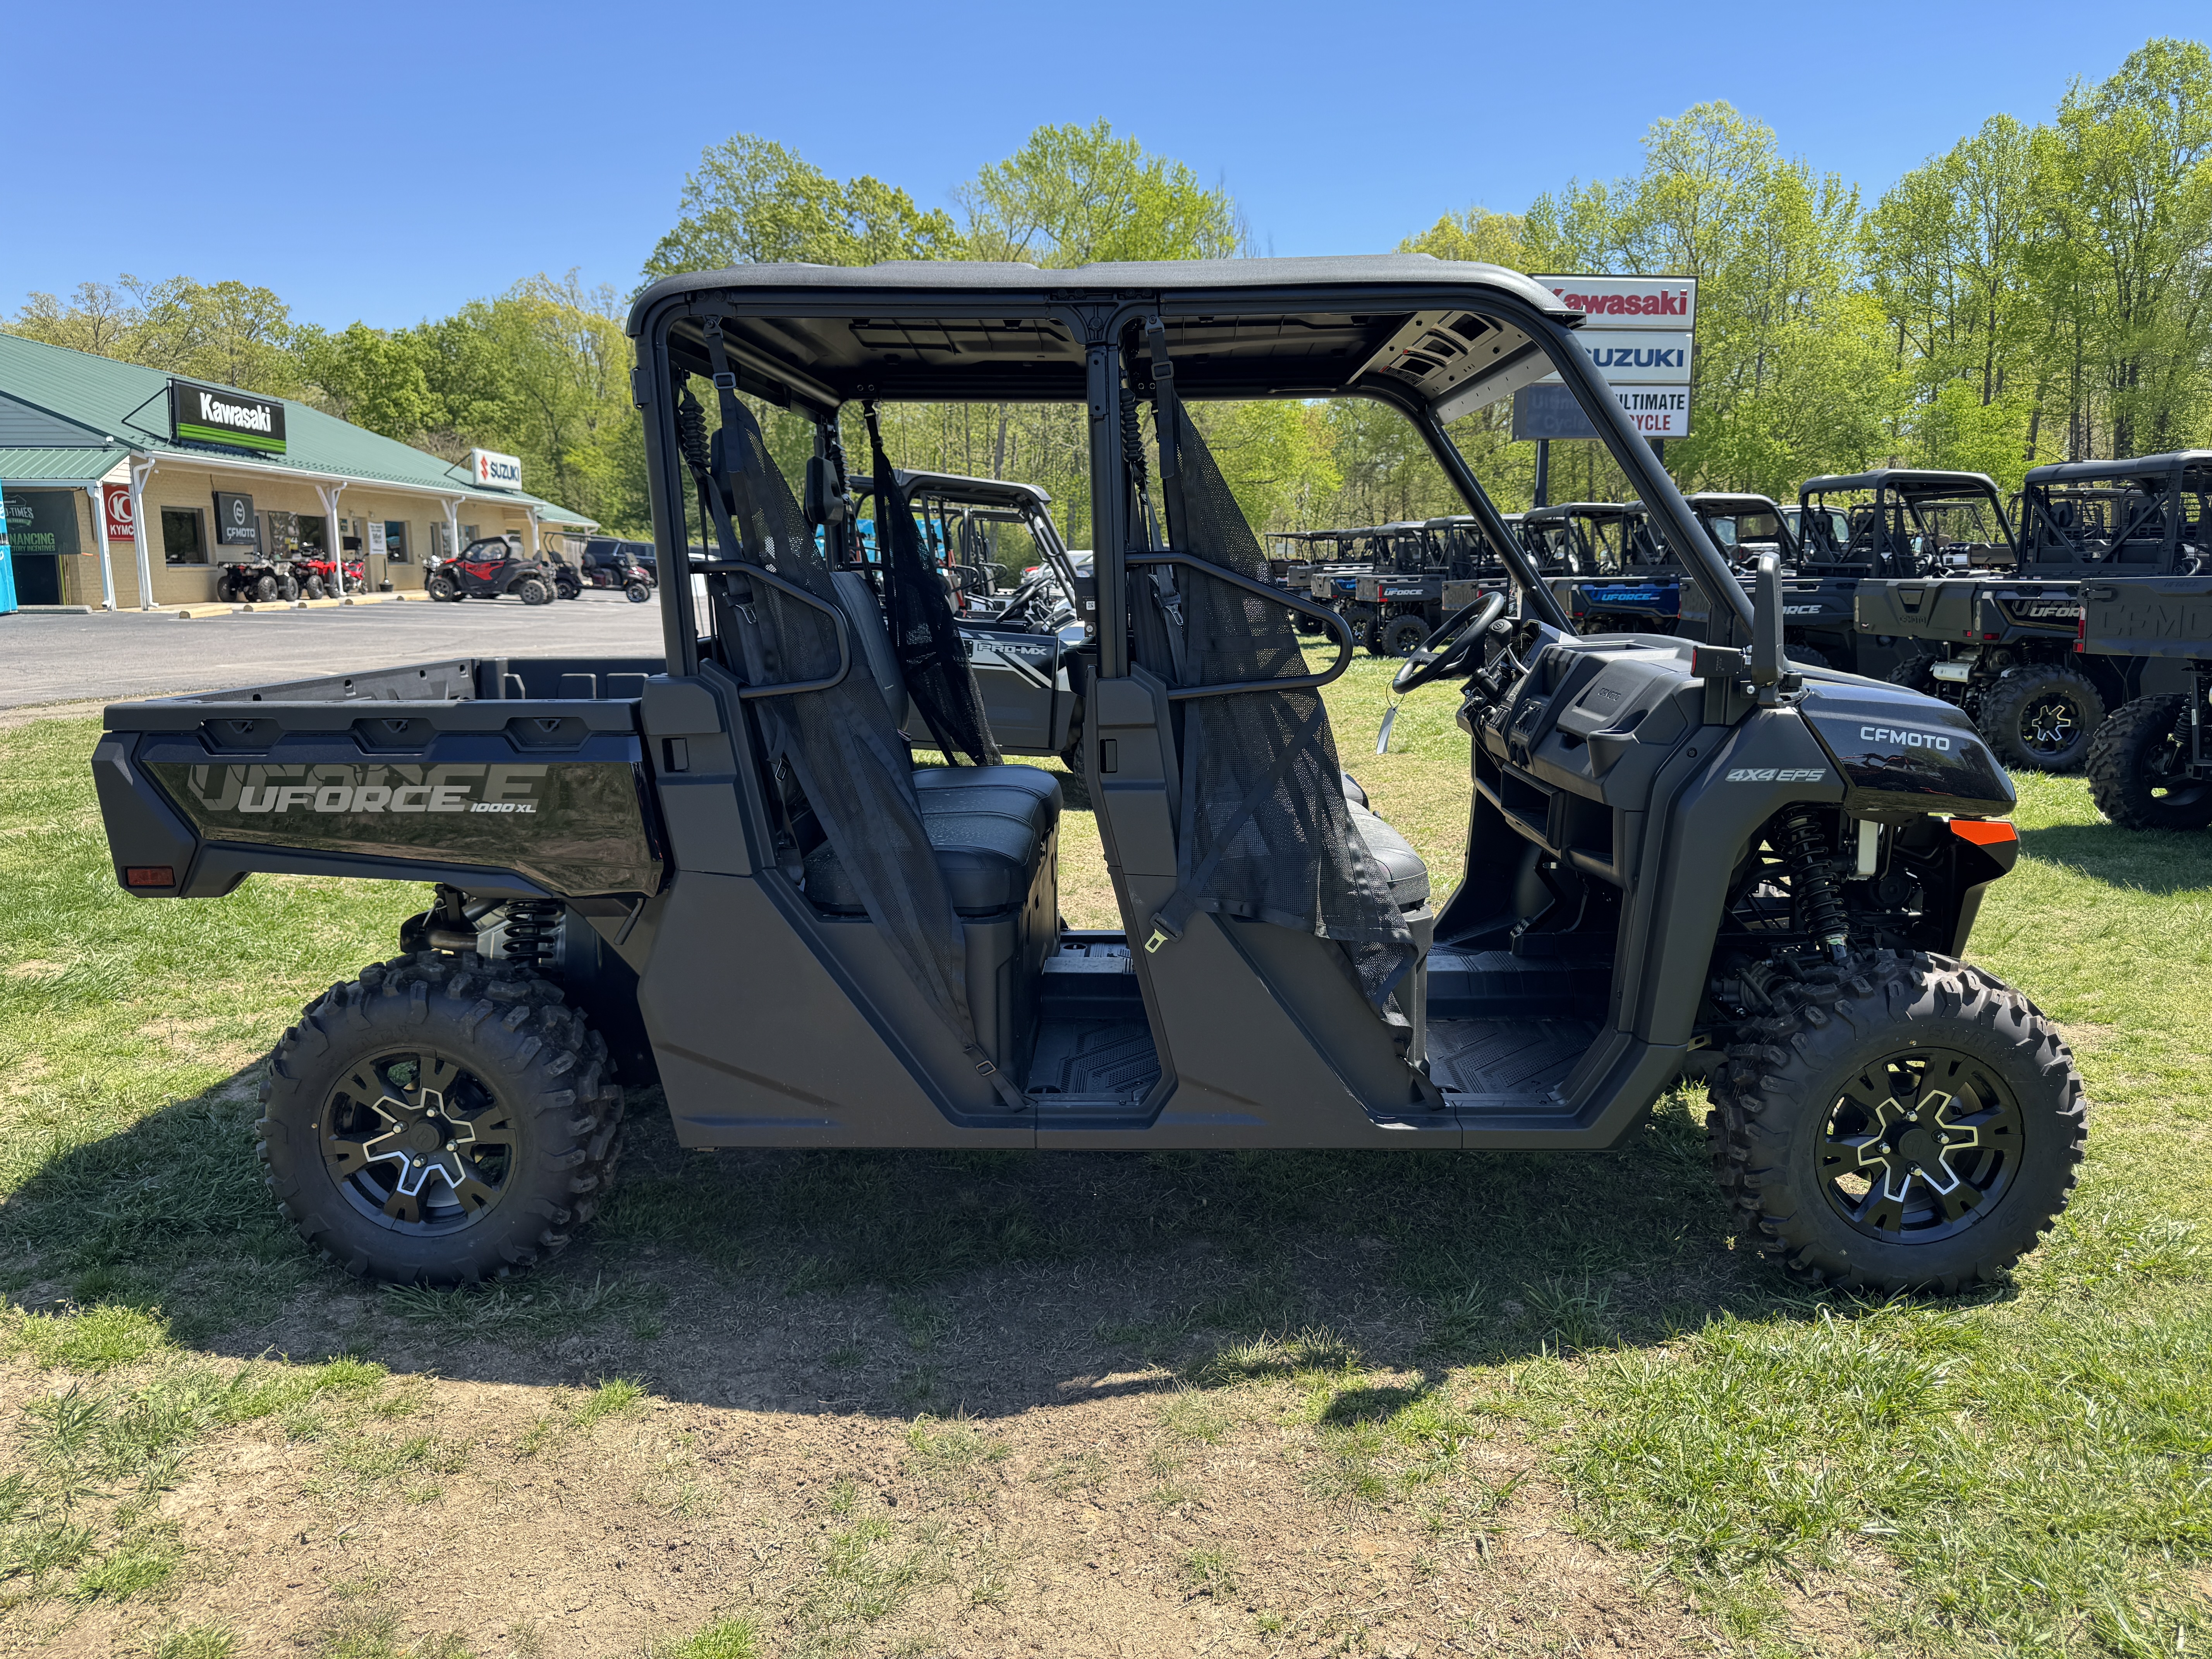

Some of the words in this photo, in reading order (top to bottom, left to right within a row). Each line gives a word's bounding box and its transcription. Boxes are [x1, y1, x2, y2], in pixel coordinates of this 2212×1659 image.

[1588, 348, 1684, 367] UZUKI
[200, 392, 271, 432] Kawasaki
[1629, 414, 1671, 431] YCLE
[491, 461, 519, 481] SUZUKI
[227, 527, 255, 538] CFMOTO
[977, 643, 1048, 656] PRO-MX
[1860, 726, 1950, 751] CFMOTO
[1727, 769, 1776, 781] 4X4
[1776, 770, 1826, 781] EPS
[238, 785, 471, 812] UFORCE
